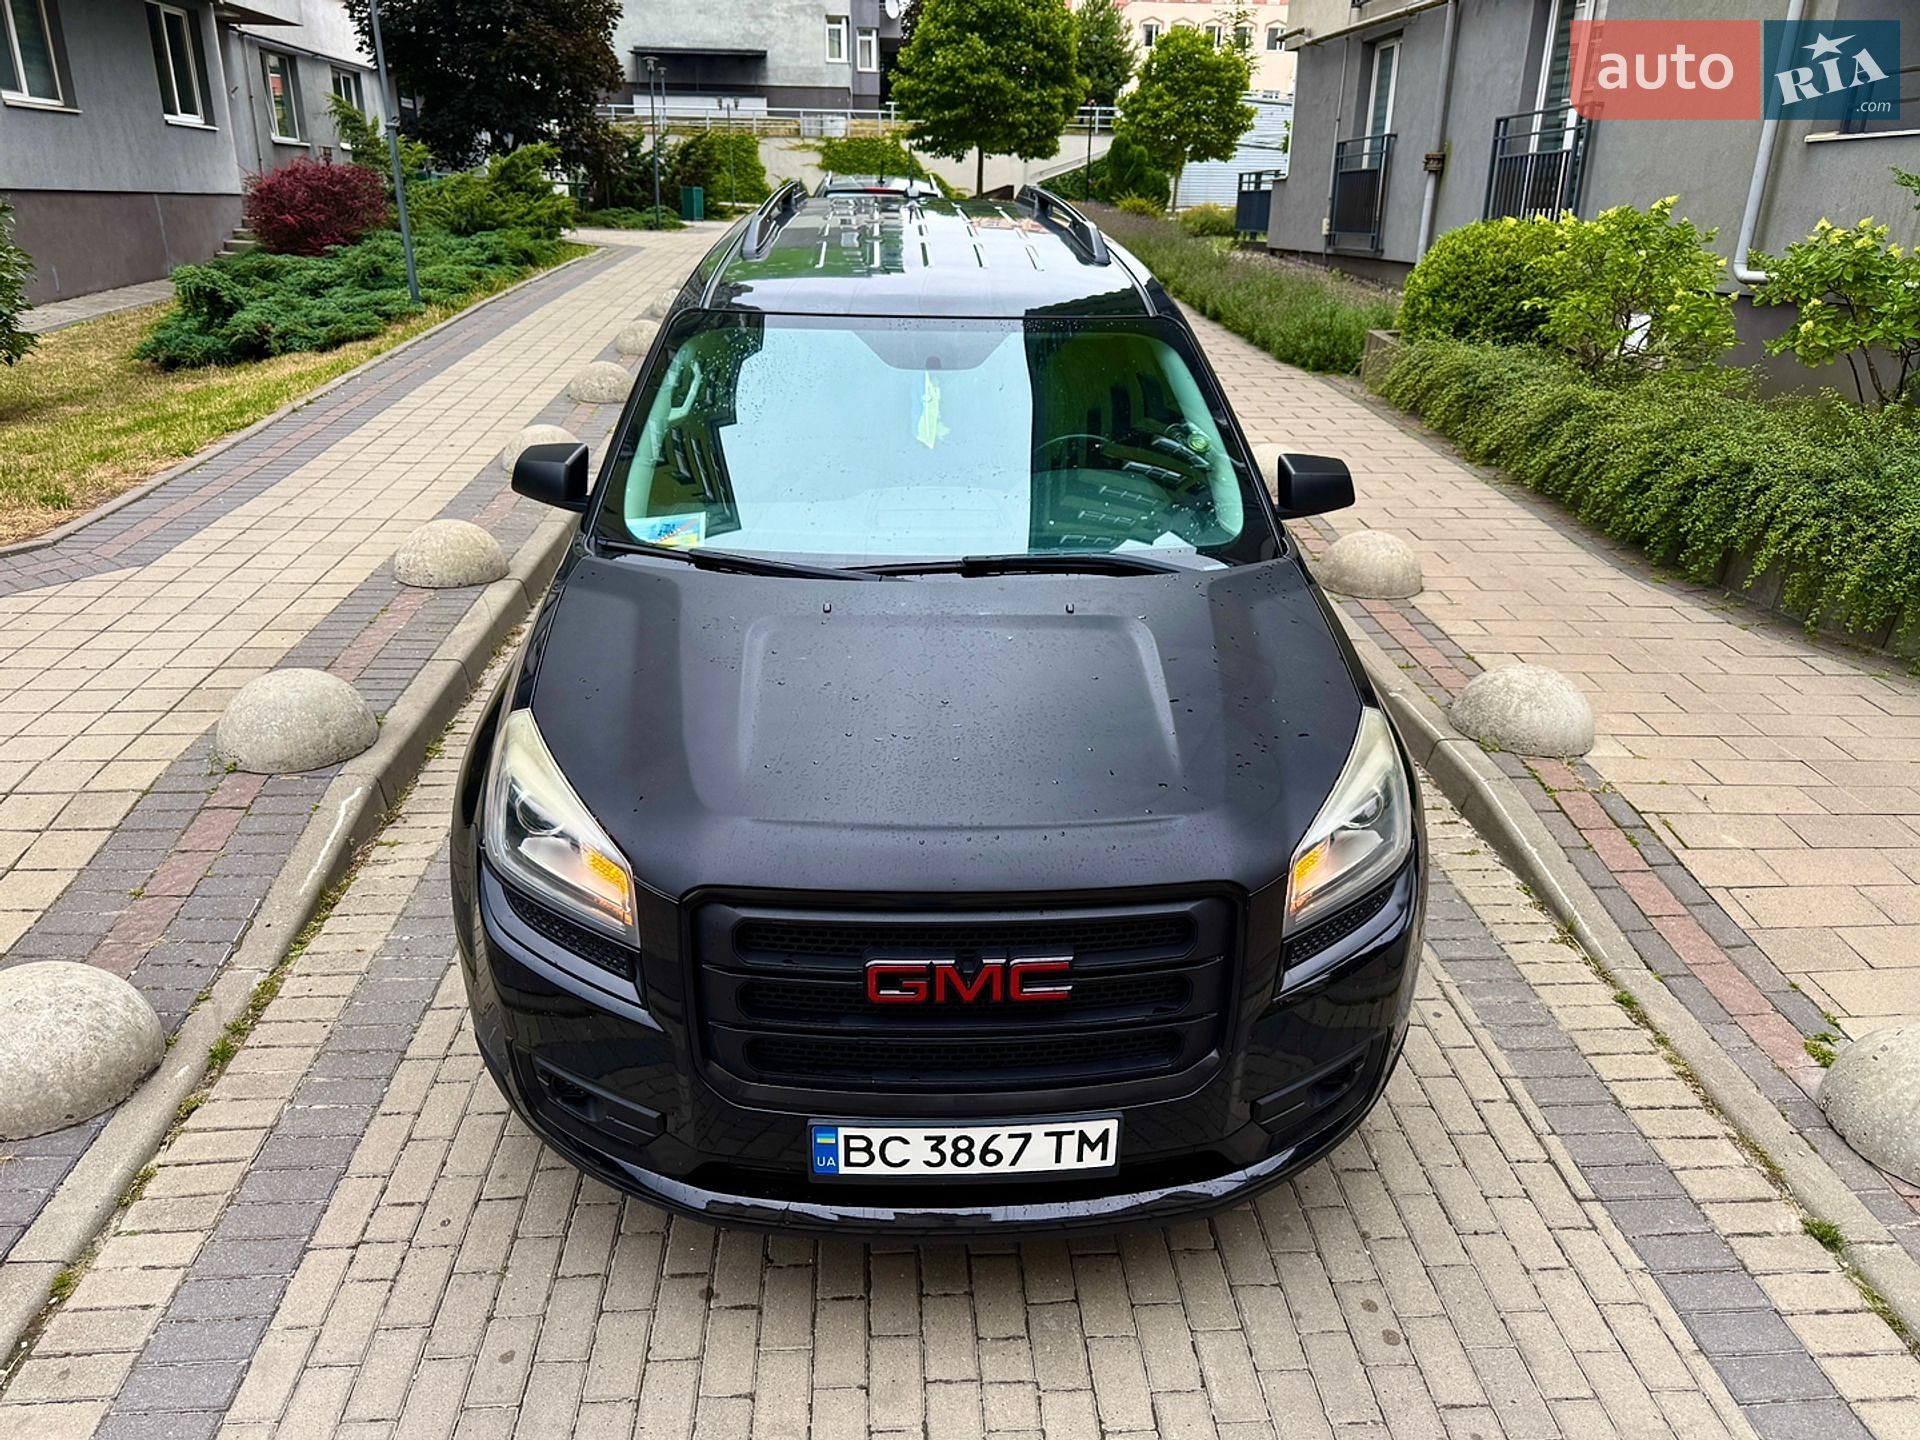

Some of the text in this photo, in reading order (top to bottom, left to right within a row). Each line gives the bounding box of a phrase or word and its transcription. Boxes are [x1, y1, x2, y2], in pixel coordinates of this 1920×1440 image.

[865, 956, 1074, 1004] GMC
[816, 1155, 836, 1167] UA
[843, 1128, 1110, 1169] BC 3867 TM
